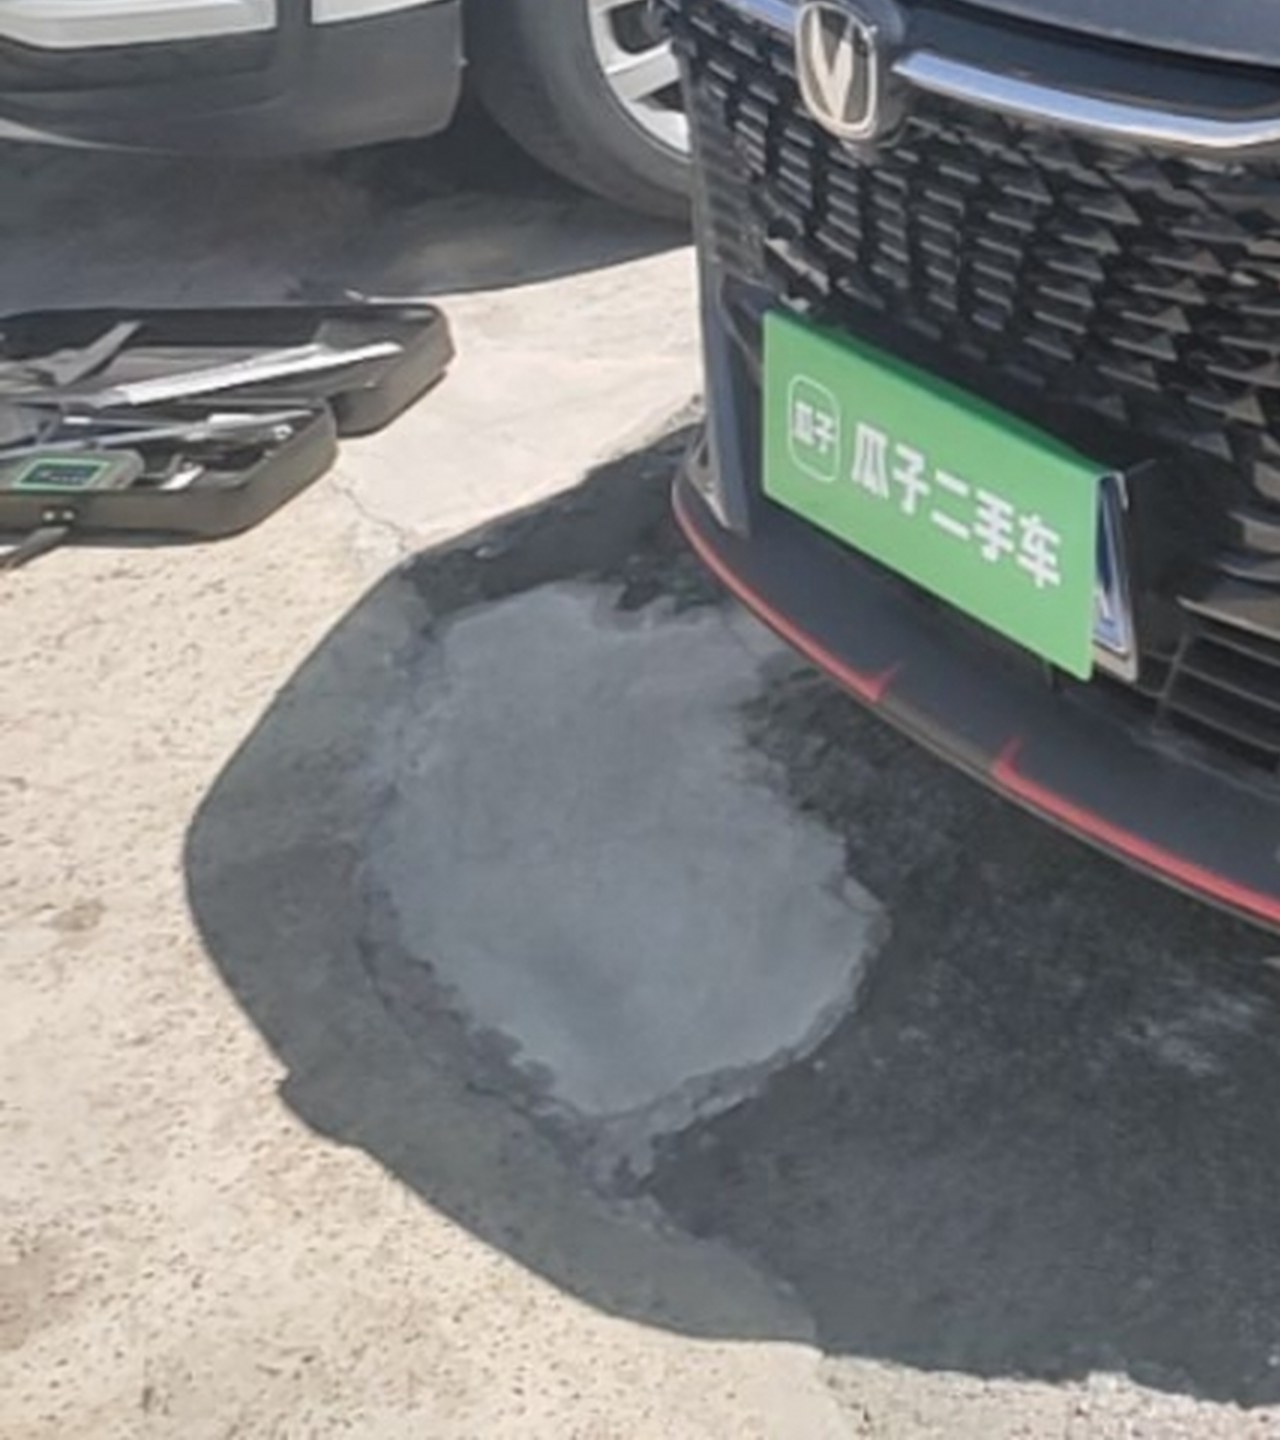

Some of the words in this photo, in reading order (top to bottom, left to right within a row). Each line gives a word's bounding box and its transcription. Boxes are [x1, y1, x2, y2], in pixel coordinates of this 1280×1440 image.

[850, 422, 1061, 590] 瓜子二手车
